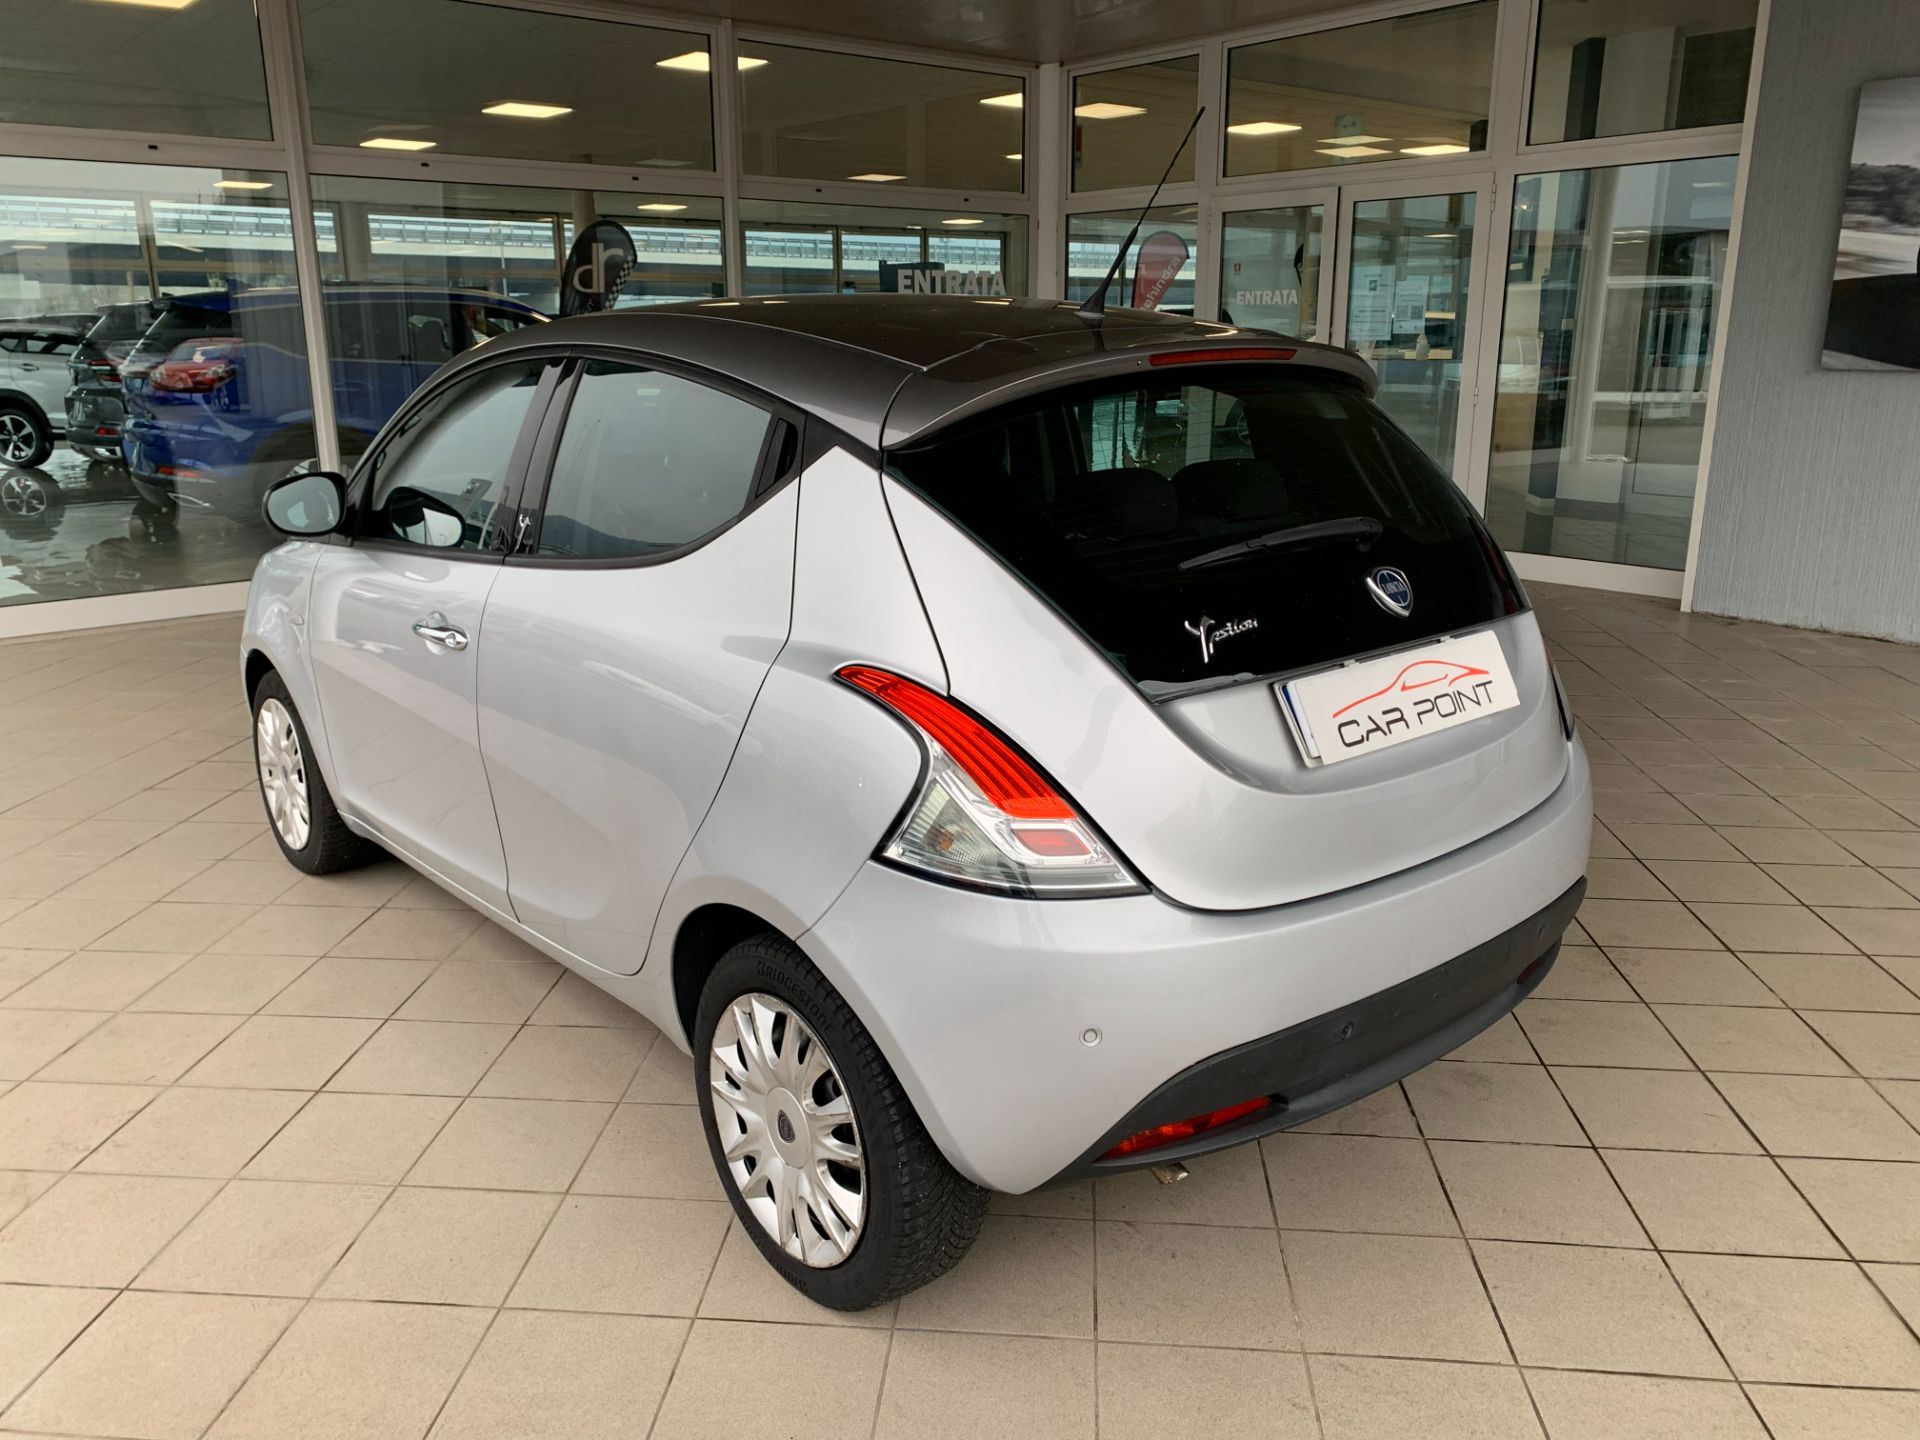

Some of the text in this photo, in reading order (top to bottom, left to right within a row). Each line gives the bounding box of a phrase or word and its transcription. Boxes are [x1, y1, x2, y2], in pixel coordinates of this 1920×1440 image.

[573, 242, 624, 293] dr
[898, 268, 1006, 296] ENTRATA
[1142, 256, 1181, 310] ahindra
[1236, 289, 1298, 305] ENTRATA
[1337, 680, 1493, 748] CAR POINT
[756, 960, 834, 1035] BRIDGESTONE
